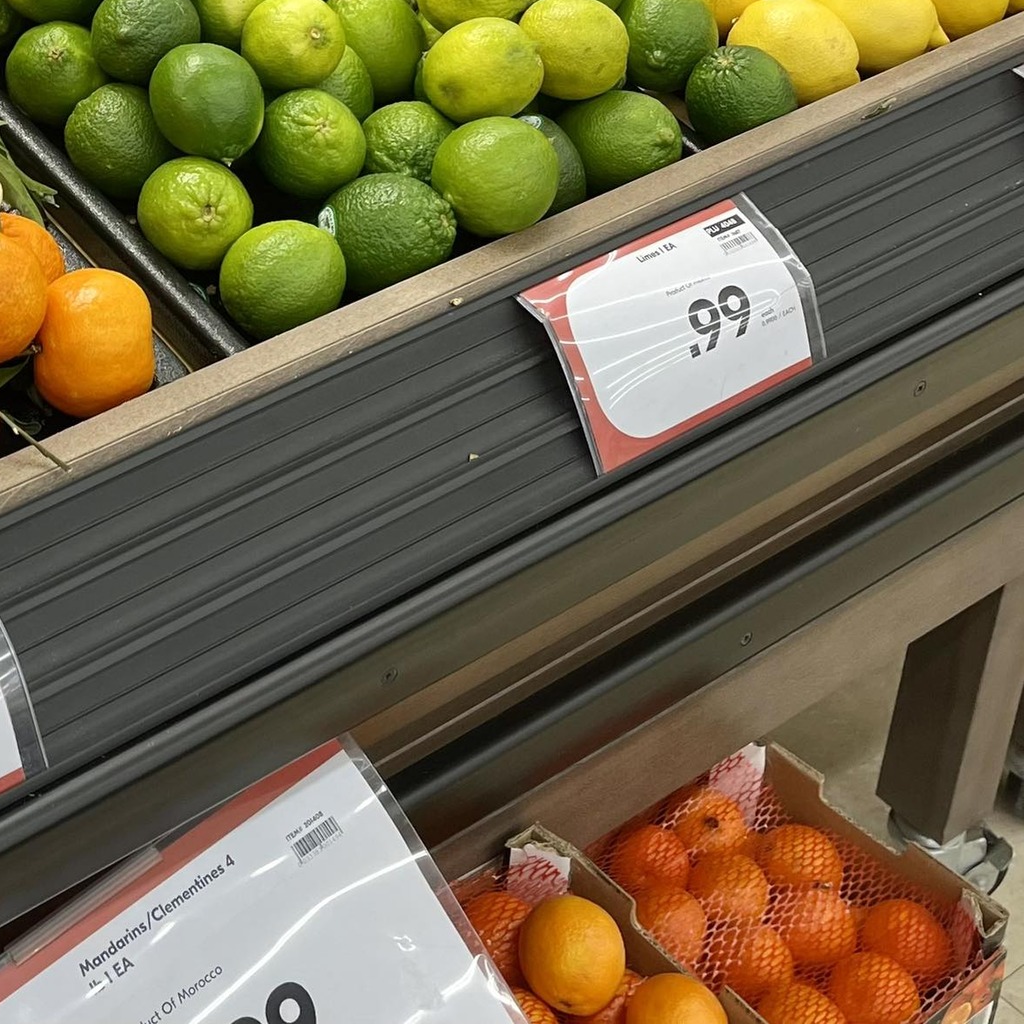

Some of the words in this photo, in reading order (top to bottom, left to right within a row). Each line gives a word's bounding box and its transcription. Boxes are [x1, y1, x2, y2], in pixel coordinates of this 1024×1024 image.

[705, 225, 720, 235] PLU
[636, 250, 661, 263] Limes
[662, 242, 677, 252] EA
[78, 864, 226, 978] Mandarins/Clementines
[225, 853, 236, 869] 4
[112, 956, 136, 978] EA
[161, 996, 177, 1015] Of
[177, 965, 223, 1004] Morocco
